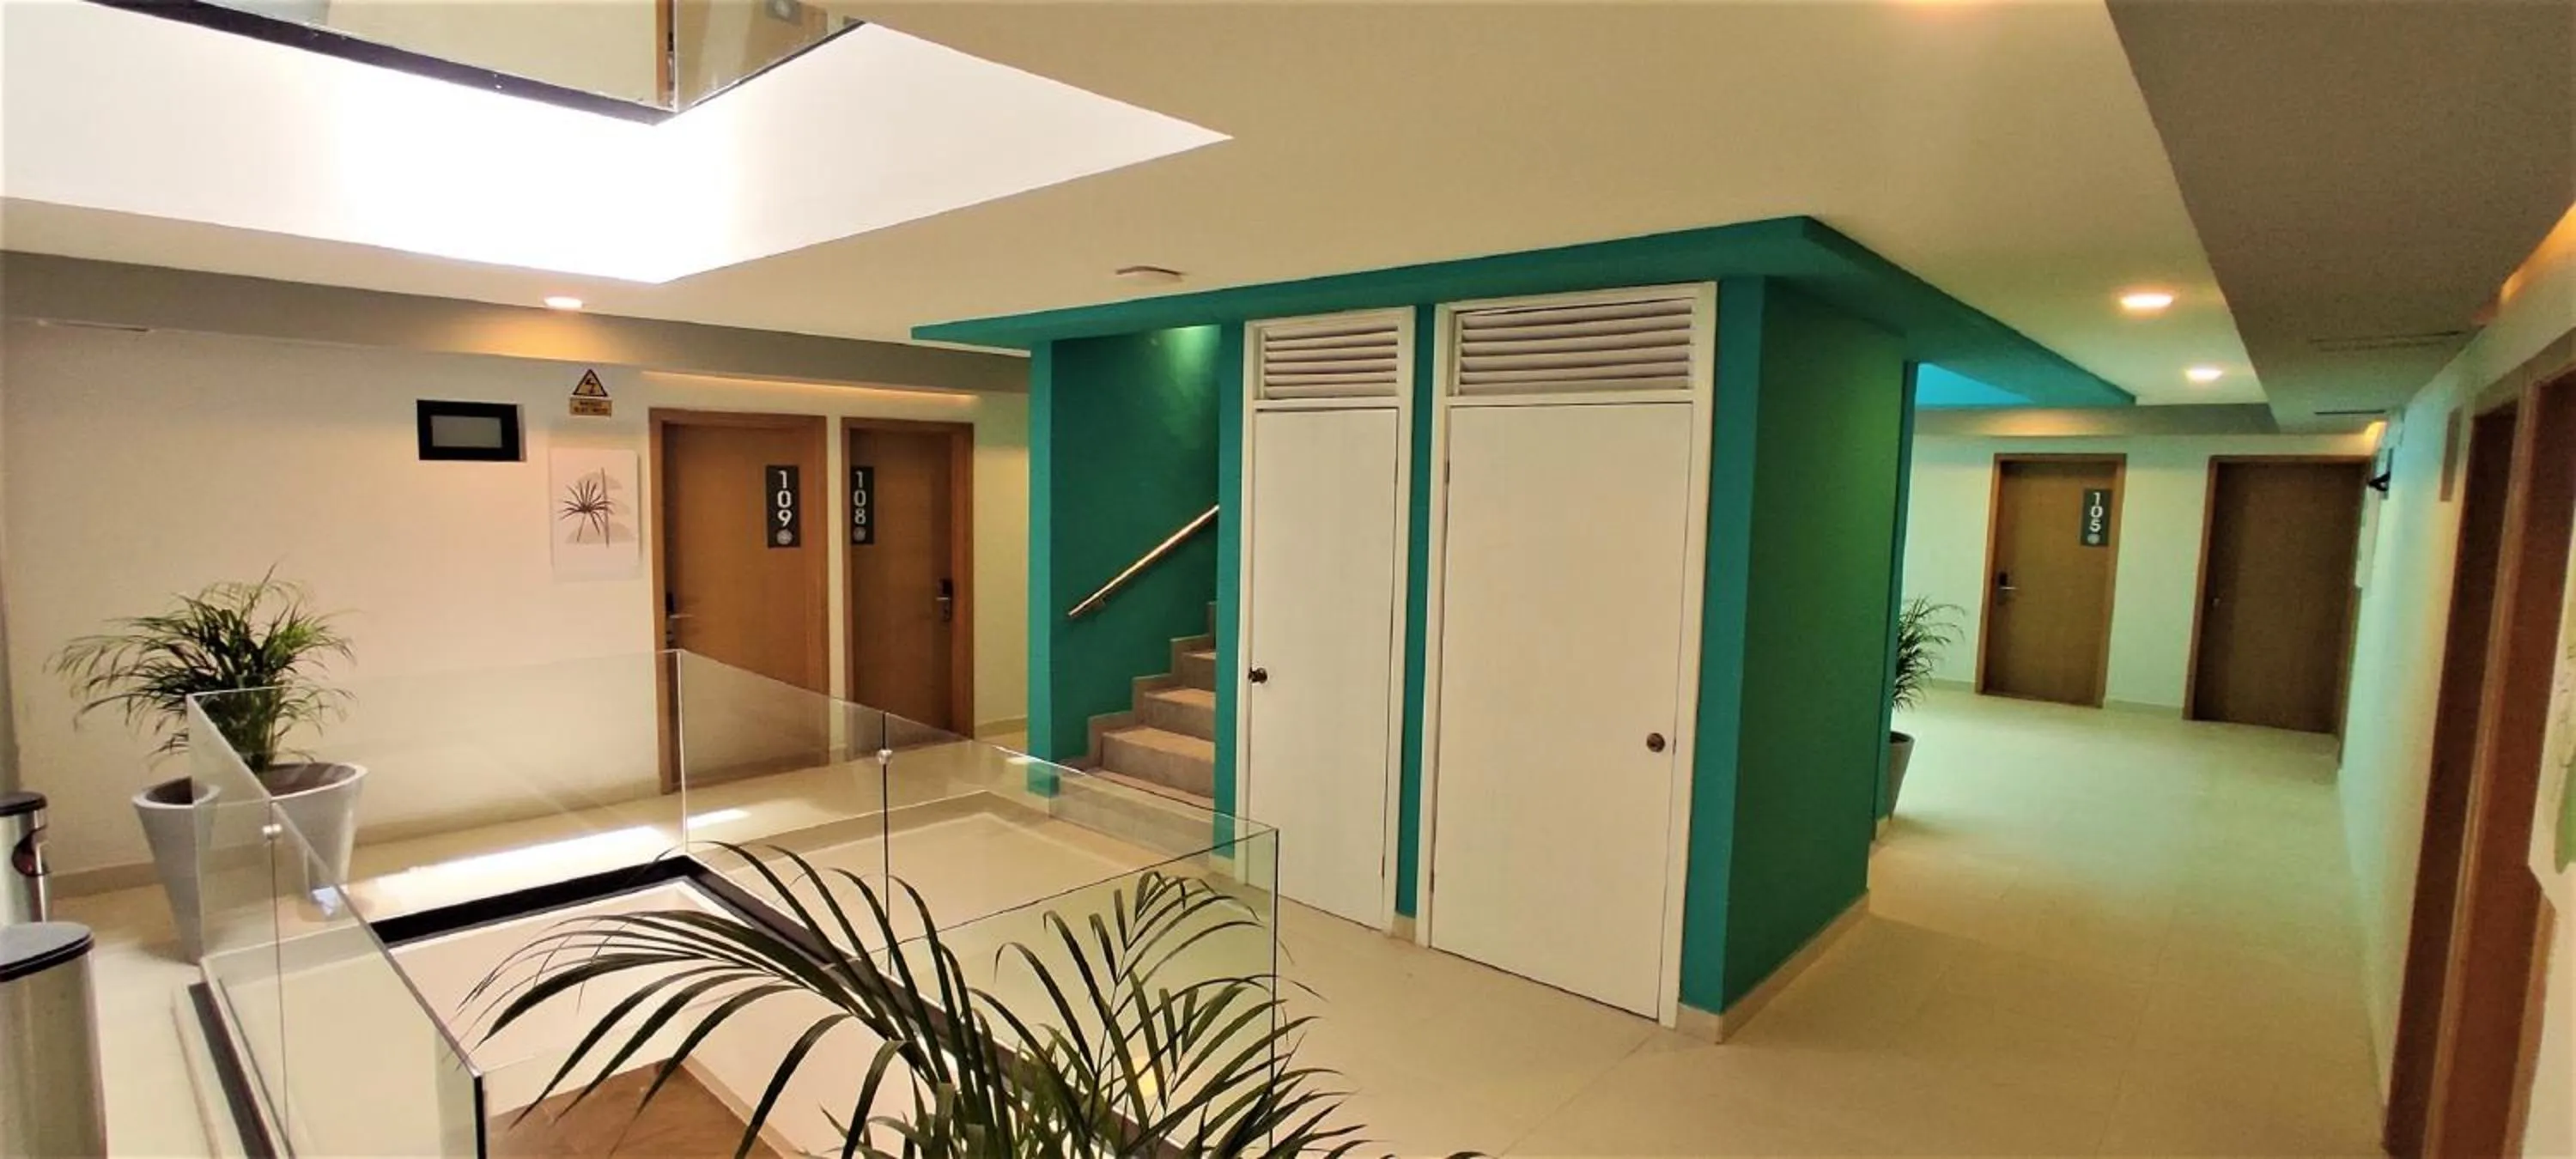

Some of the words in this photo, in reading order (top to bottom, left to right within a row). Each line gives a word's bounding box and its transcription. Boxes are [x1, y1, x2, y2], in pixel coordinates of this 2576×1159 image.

[777, 470, 793, 527] 109
[854, 470, 866, 525] 108
[2089, 492, 2104, 532] 105
